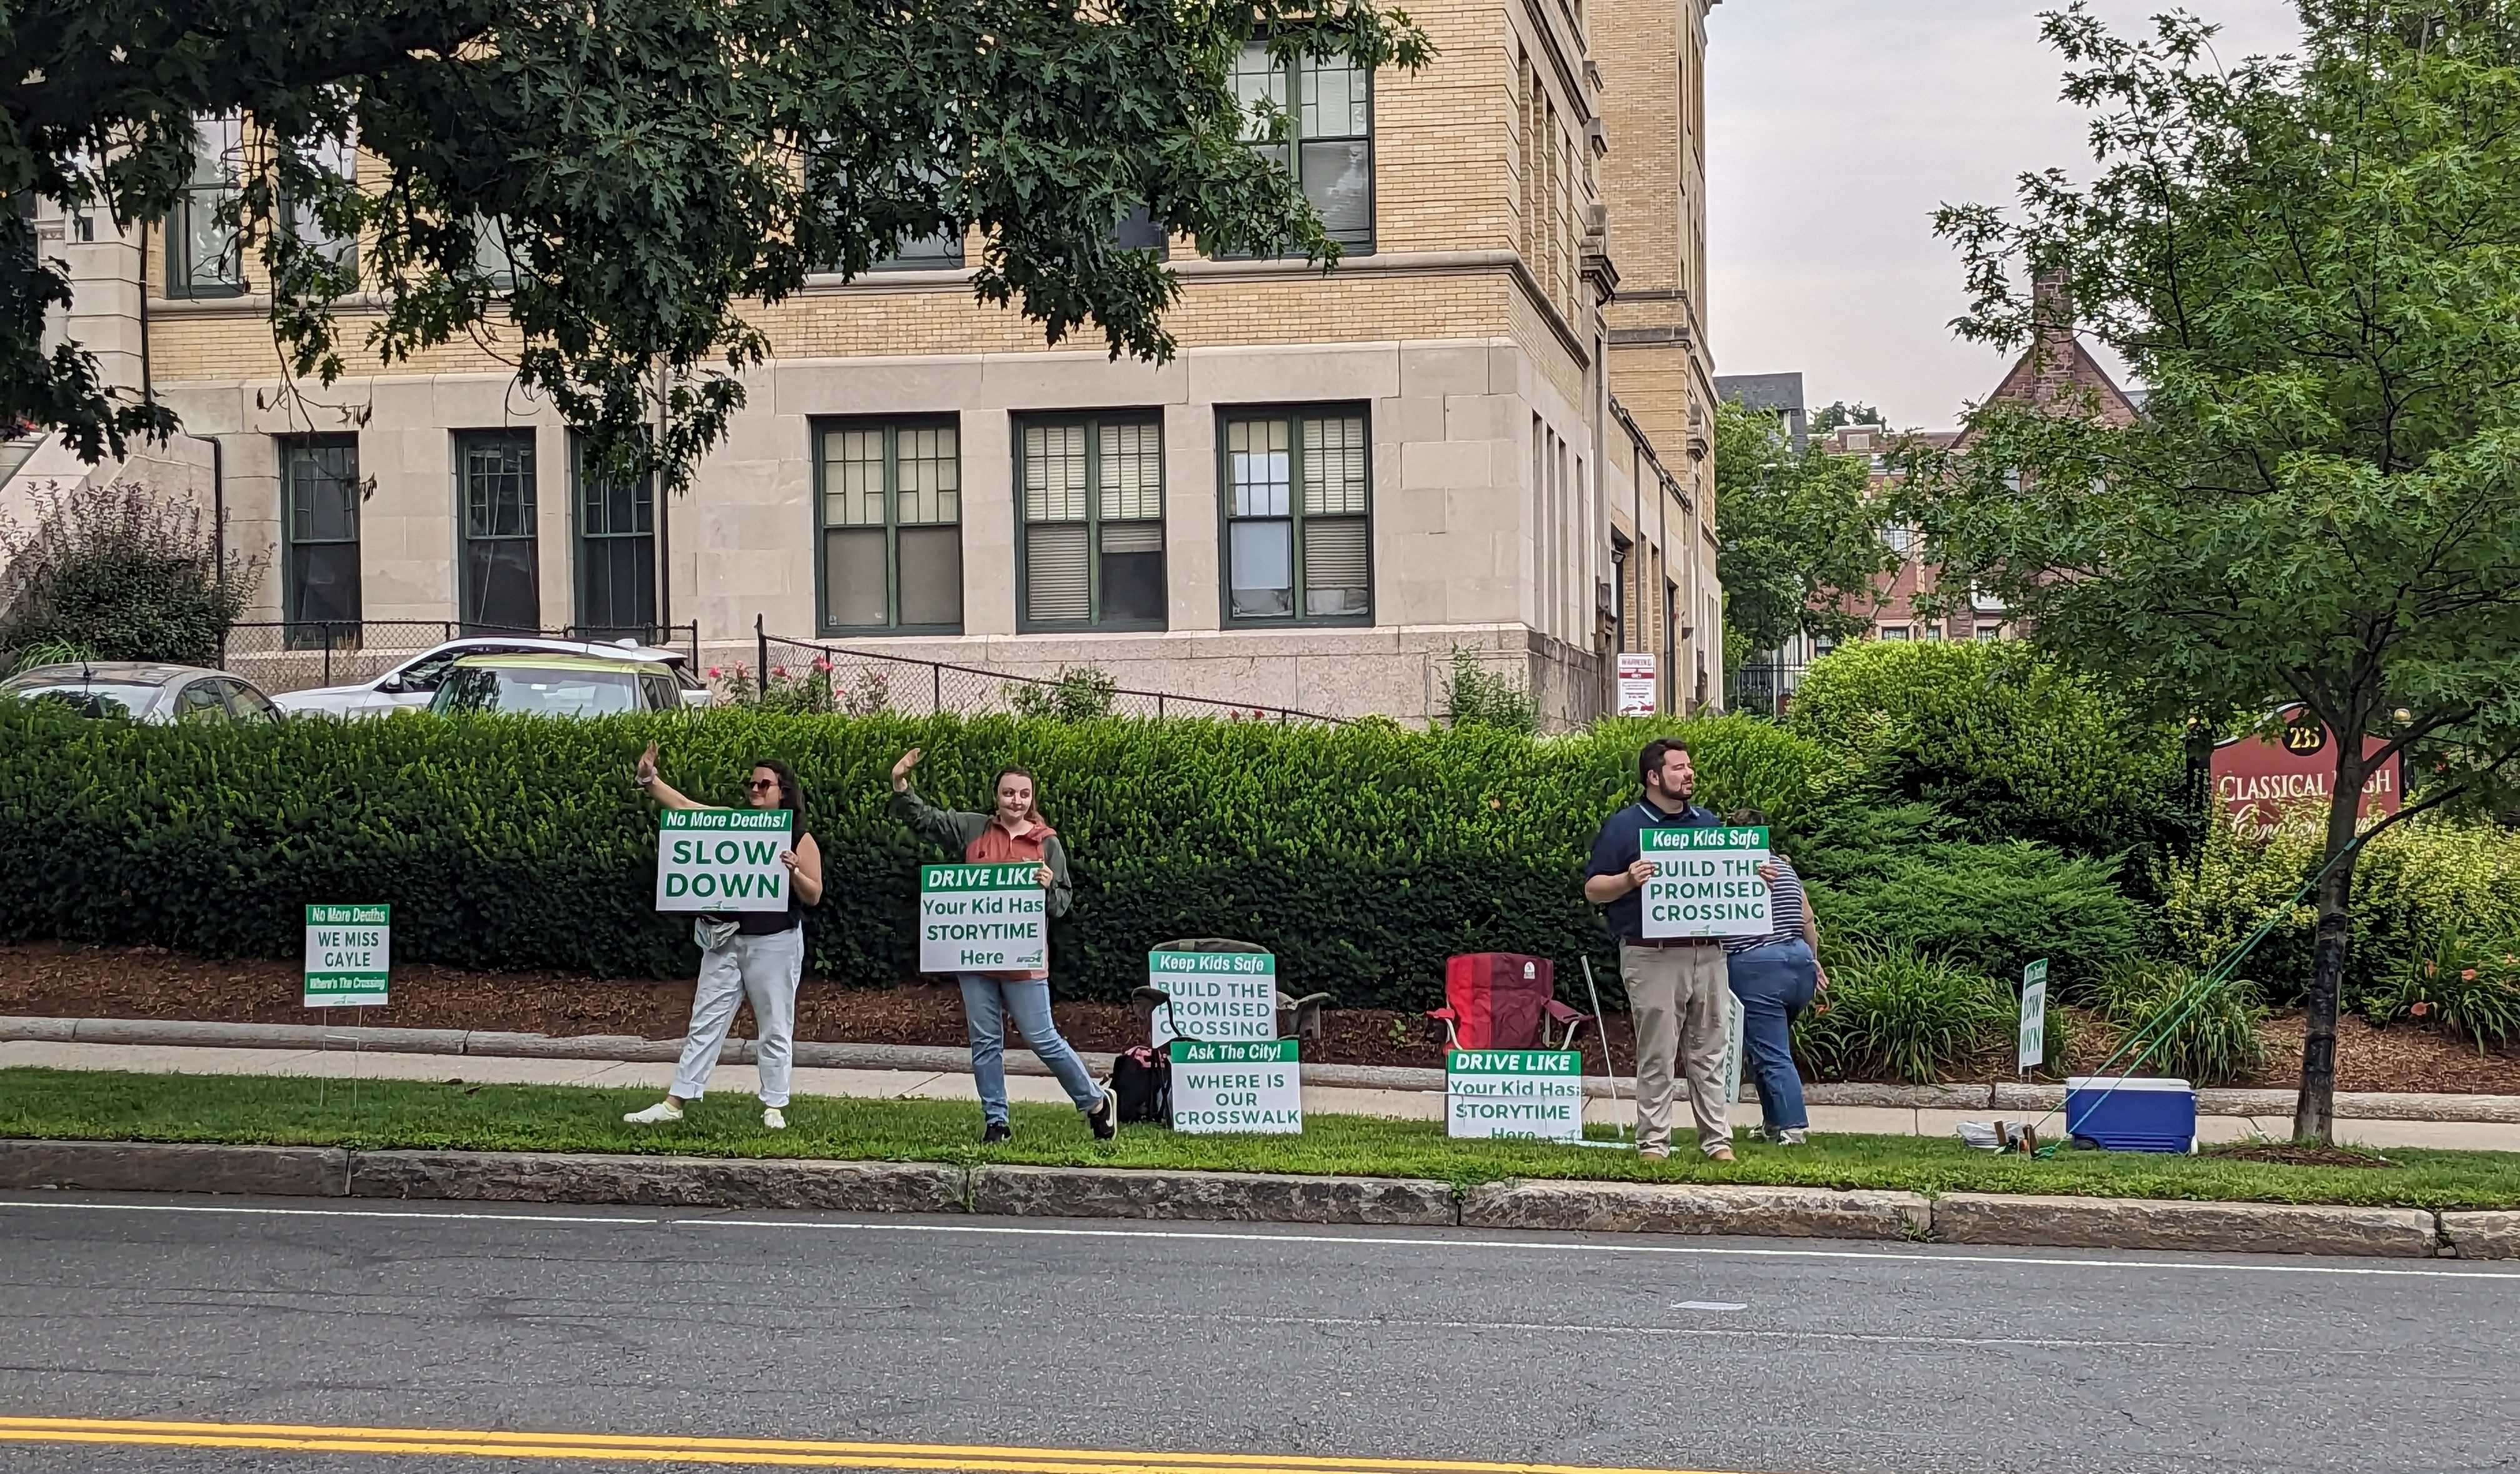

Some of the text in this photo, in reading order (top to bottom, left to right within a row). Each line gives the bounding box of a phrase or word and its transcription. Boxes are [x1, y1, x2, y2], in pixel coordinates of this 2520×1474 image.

[2219, 773, 2328, 801] CLASSICAL
[666, 812, 787, 827] No More Deaths!
[1653, 830, 1759, 850] Keep Kids Safe
[672, 840, 778, 865] SLOW
[1652, 860, 1763, 878] BUILD THE
[666, 873, 780, 898] DOWN
[929, 868, 1039, 888] DRIVE LIKE
[1650, 881, 1765, 900] PROMISED
[922, 896, 1043, 915] Your Kid Has
[1652, 903, 1764, 921] CROSSING
[312, 908, 386, 923] No More Deaths
[318, 931, 379, 947] WE MISS
[926, 923, 1038, 941] STORYTIME
[325, 952, 371, 967] GAYLE
[961, 950, 1004, 965] Here
[1160, 955, 1264, 974] Keep Kids Safe
[310, 976, 386, 990] Where's The Crossing
[1158, 981, 1269, 998] BUILD THE
[1160, 1021, 1269, 1036] CROSSING
[1188, 1044, 1281, 1062] Ask The City!
[1456, 1054, 1571, 1071] DRIVE LIKE
[1186, 1074, 1284, 1089] WHERE IS
[1451, 1081, 1496, 1095] Your
[1501, 1080, 1533, 1095] Kid
[1216, 1093, 1258, 1106] OUR
[1174, 1110, 1299, 1125] CROSSWALK
[1456, 1104, 1570, 1120] STORYTIME
